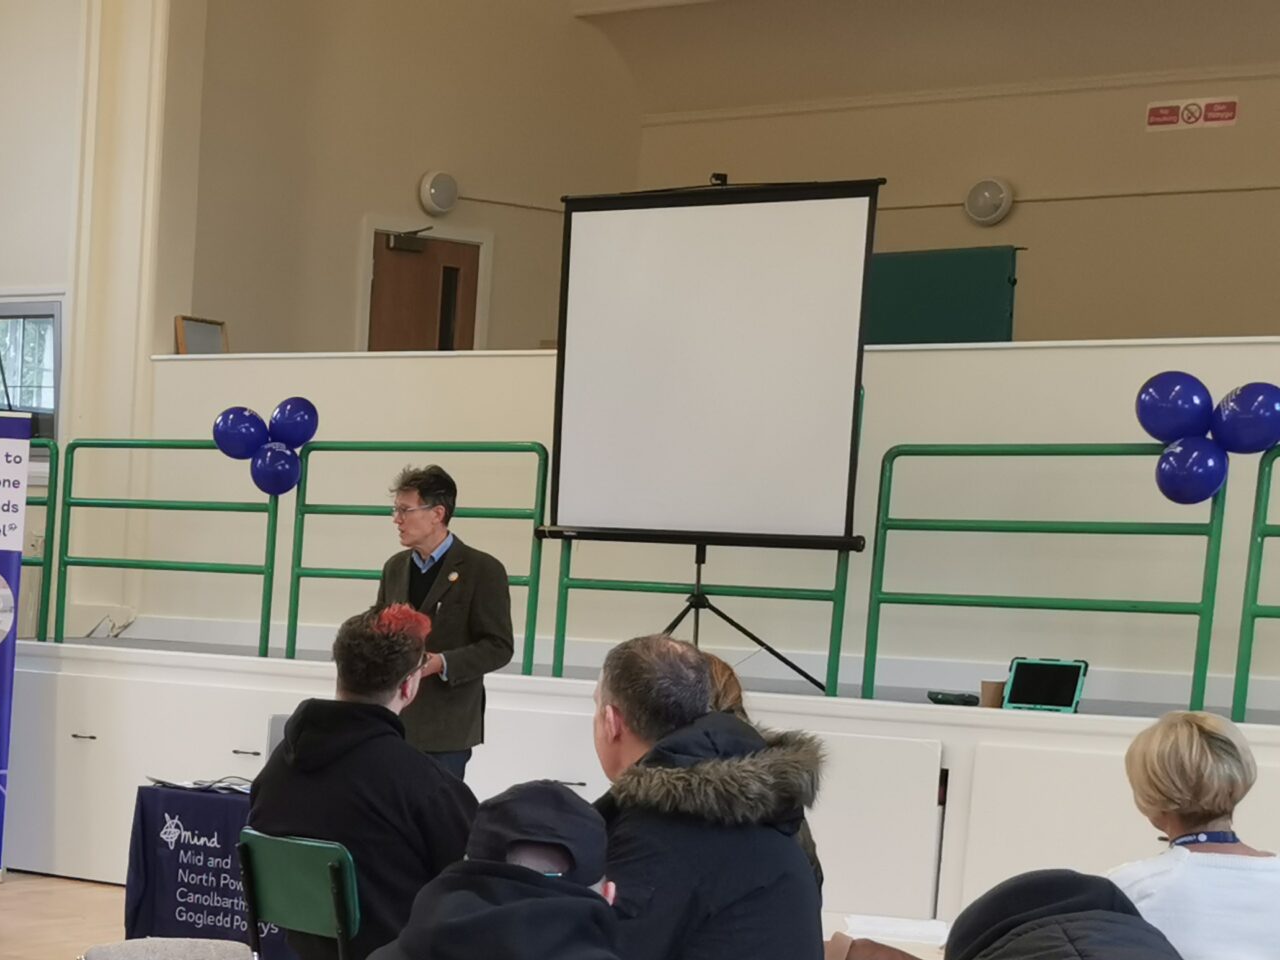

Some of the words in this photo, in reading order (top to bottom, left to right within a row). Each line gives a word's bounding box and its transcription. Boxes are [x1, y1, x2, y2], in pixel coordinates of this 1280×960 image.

[6, 452, 23, 464] to
[180, 829, 221, 848] mind
[179, 850, 204, 866] Mid
[207, 855, 231, 869] and
[178, 868, 216, 887] North
[176, 888, 245, 911] Canolbarth
[175, 907, 231, 928] Gogledd
[233, 915, 279, 937] Poys
